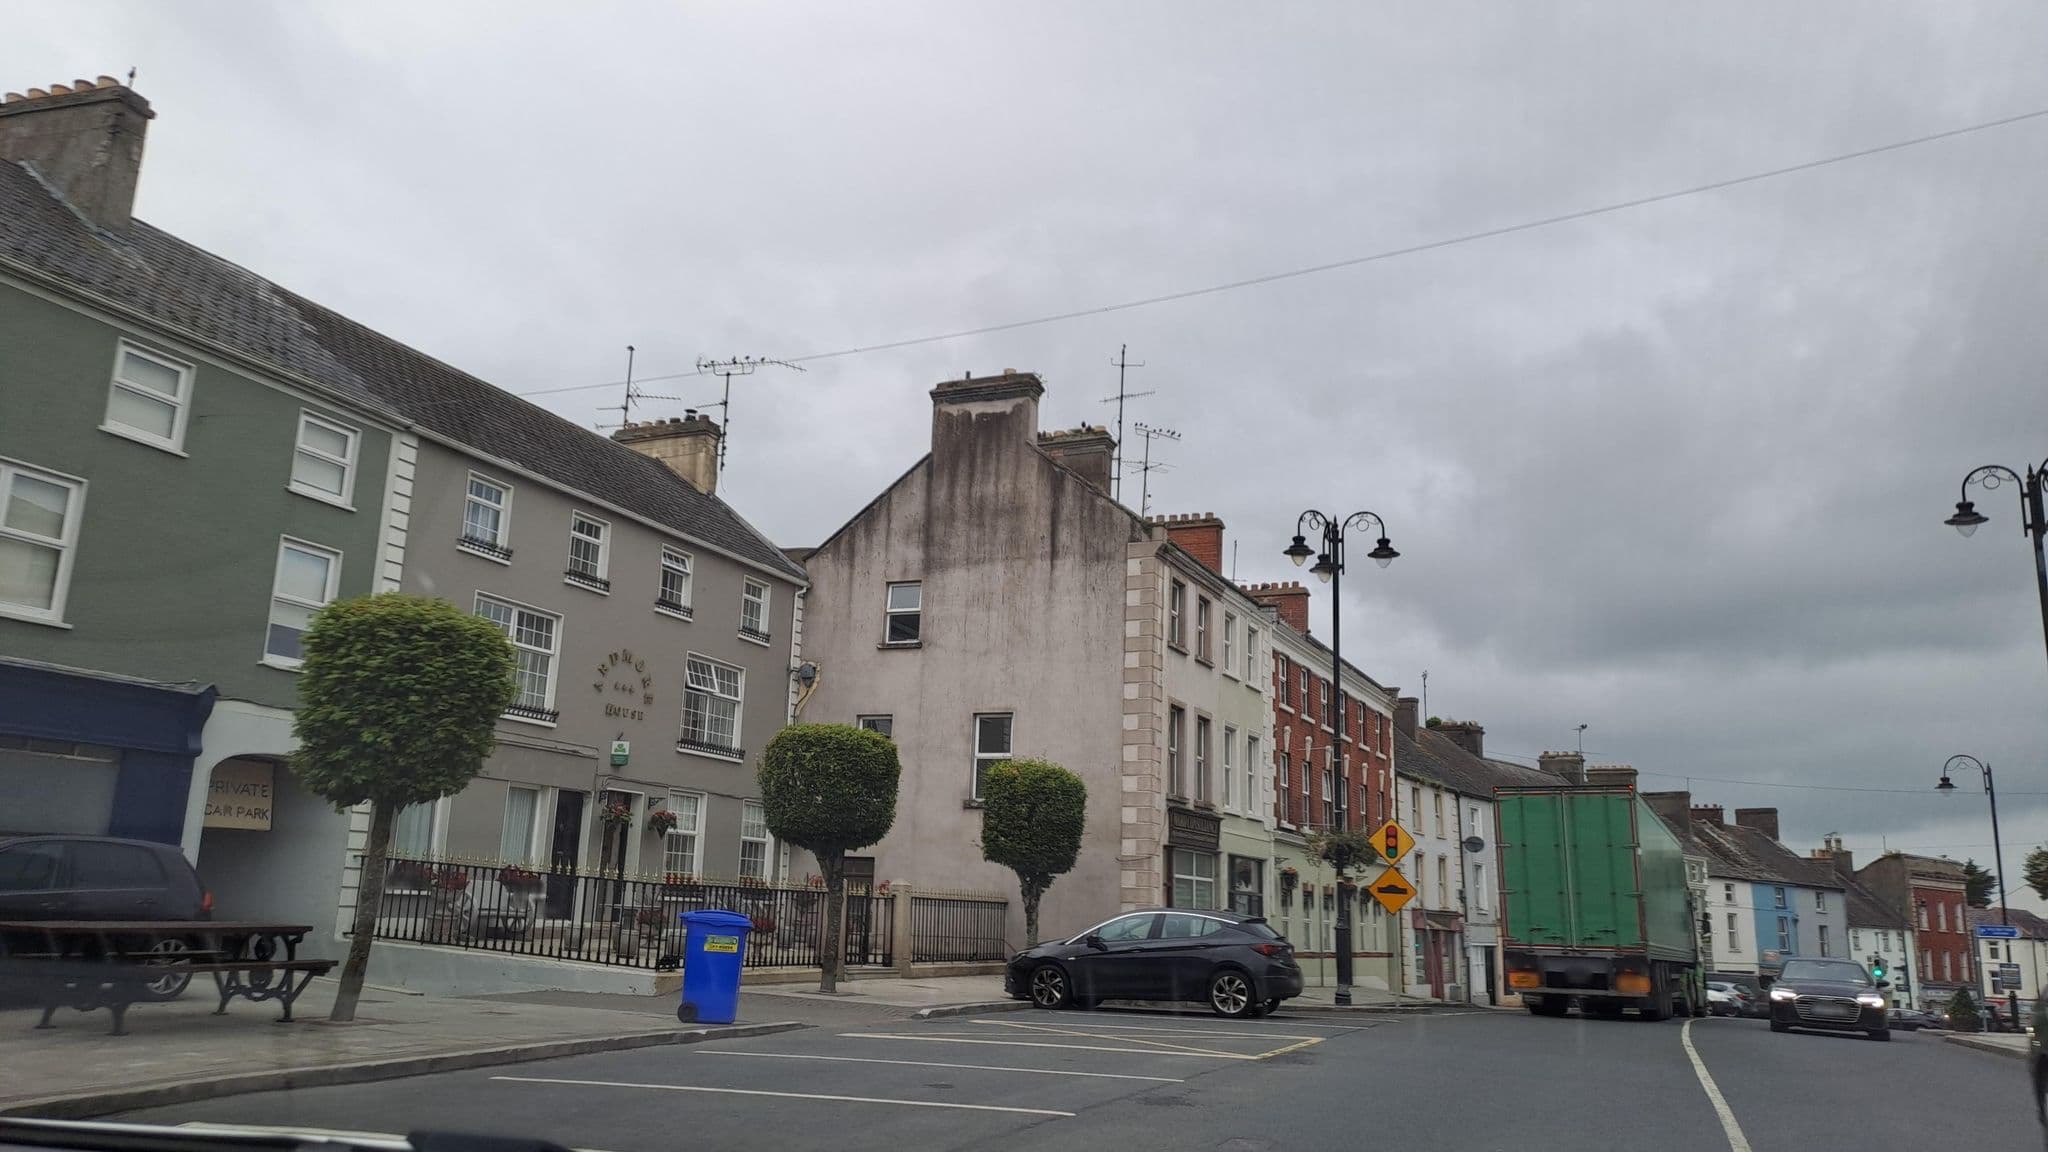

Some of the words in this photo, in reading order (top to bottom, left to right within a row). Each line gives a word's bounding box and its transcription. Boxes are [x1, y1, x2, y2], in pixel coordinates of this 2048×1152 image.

[605, 703, 643, 721] HOUSE
[204, 803, 233, 817] CAR
[236, 806, 269, 821] PARK
